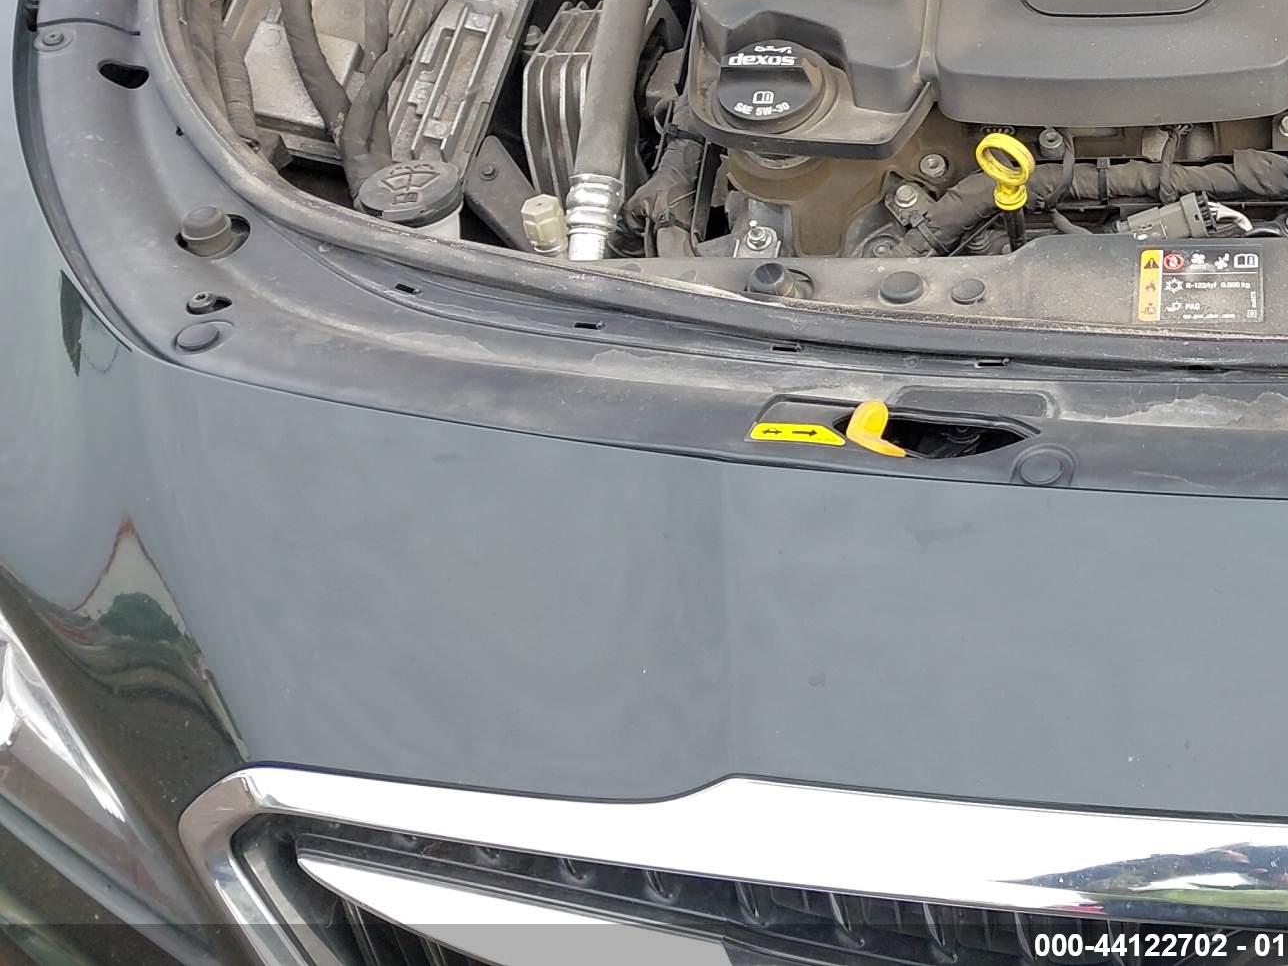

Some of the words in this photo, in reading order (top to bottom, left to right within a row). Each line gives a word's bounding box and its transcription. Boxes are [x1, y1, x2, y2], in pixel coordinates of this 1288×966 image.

[728, 52, 797, 66] dexos
[734, 102, 753, 114] SAE
[756, 101, 790, 115] 5W-30
